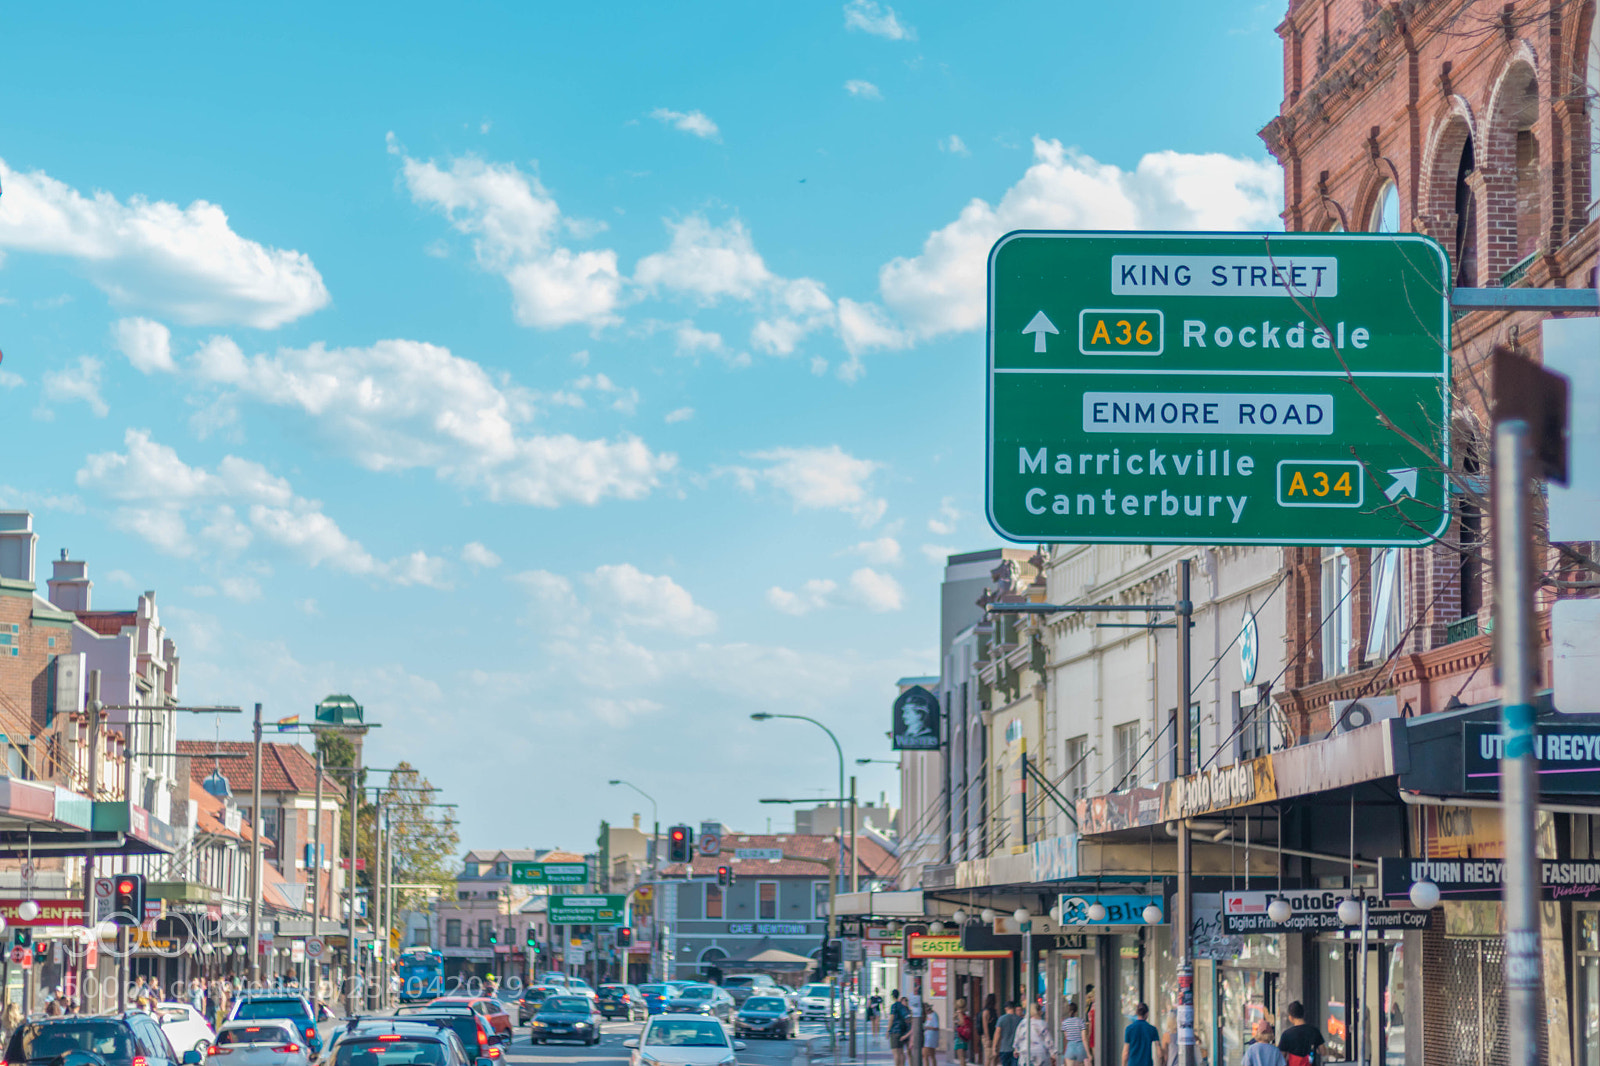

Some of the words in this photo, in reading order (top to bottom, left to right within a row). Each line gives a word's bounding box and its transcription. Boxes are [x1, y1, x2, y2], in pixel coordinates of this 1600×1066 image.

[1121, 264, 1191, 287] KING
[1211, 265, 1328, 288] STREET
[1091, 320, 1153, 345] A36
[1183, 320, 1370, 350] Rockdale
[1092, 402, 1220, 424] ENMORE
[1239, 404, 1323, 425] ROAD
[1019, 447, 1254, 477] Marrickville
[1288, 472, 1353, 497] A34
[1025, 488, 1248, 523] Canterbury
[1480, 734, 1543, 760] UTN
[1211, 757, 1255, 808] Garden
[1553, 884, 1597, 899] Vintage
[729, 923, 754, 935] CAFE
[756, 923, 807, 935] NEWTOWN
[1229, 916, 1257, 931] Digital
[1320, 914, 1345, 929] Desig
[1368, 913, 1402, 925] cument
[1403, 912, 1427, 927] Copy
